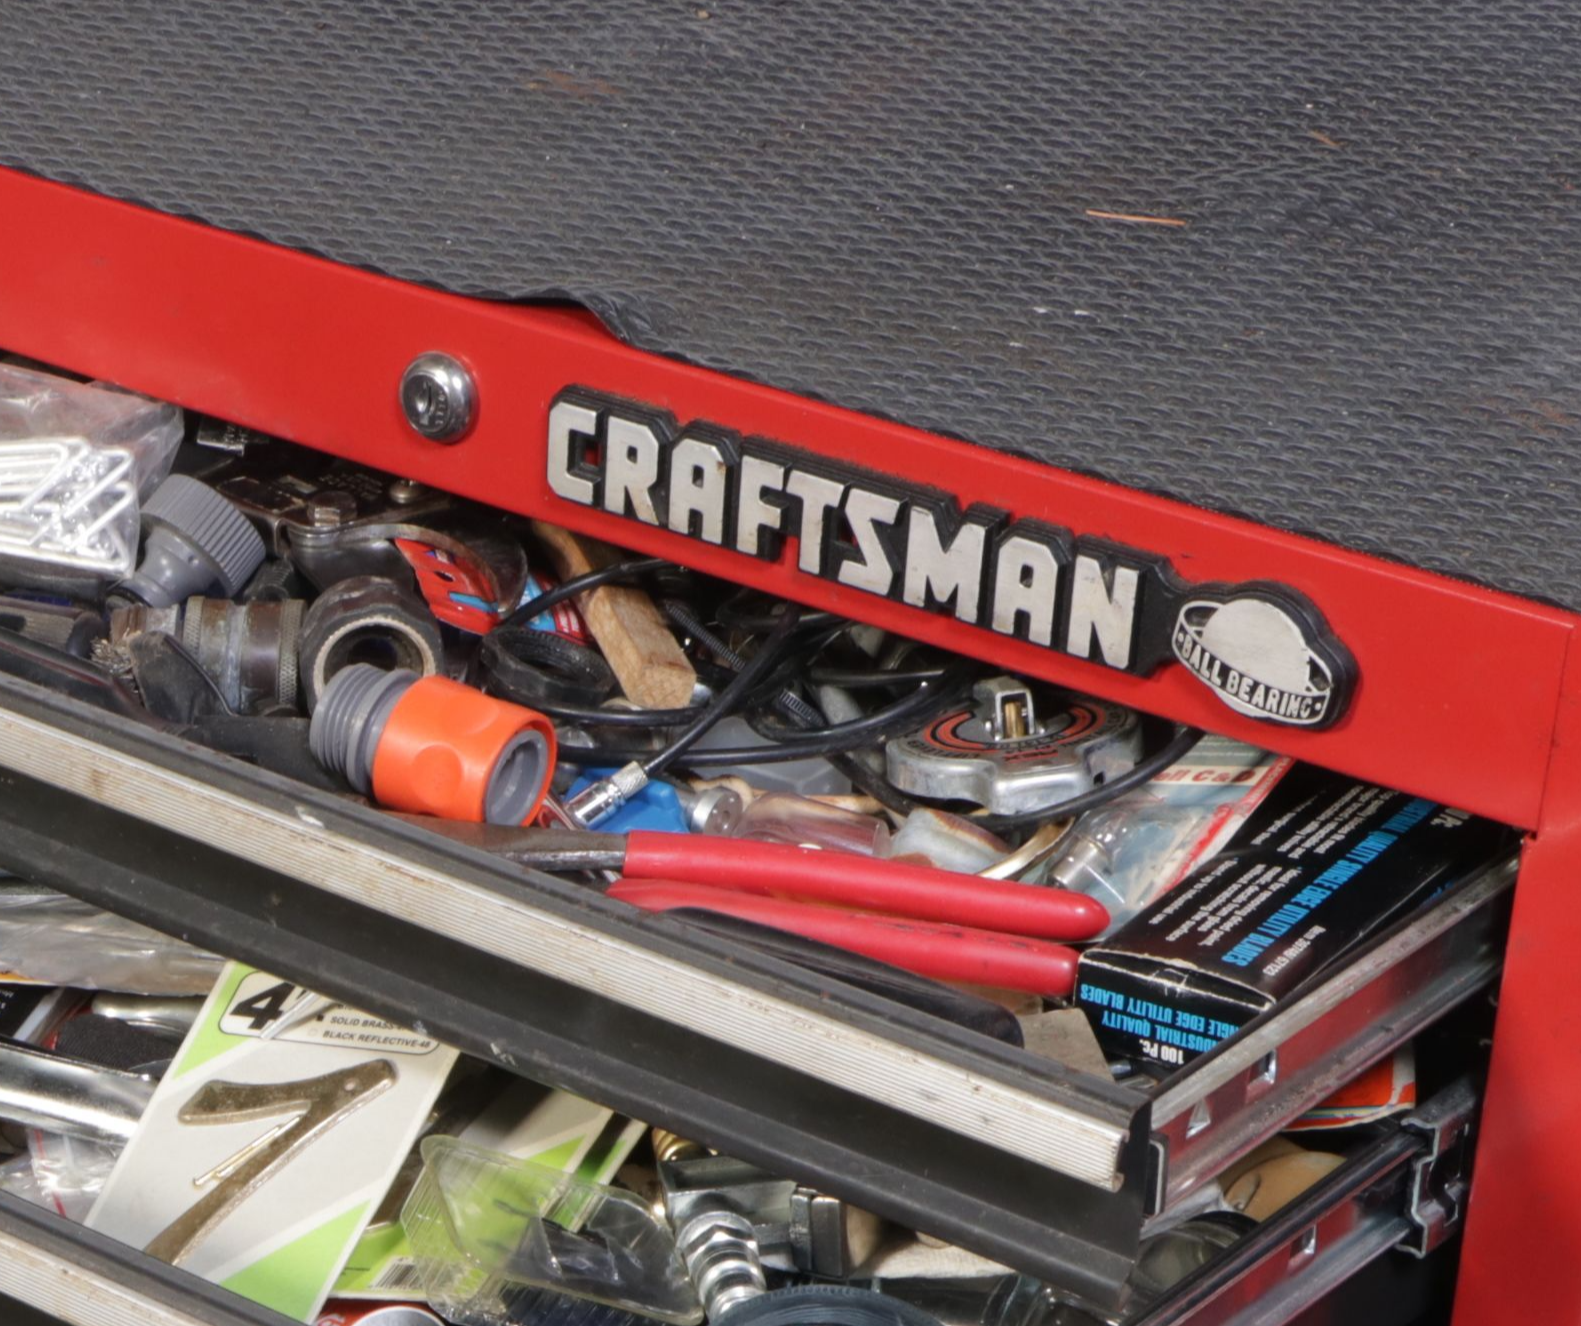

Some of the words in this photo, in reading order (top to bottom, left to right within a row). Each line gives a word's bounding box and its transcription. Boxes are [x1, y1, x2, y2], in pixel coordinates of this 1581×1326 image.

[546, 400, 1139, 671] CRAFTSMAN
[1182, 632, 1222, 688] BALL
[1224, 670, 1312, 722] BEARING
[1345, 830, 1398, 865] QUALITY
[1313, 857, 1362, 889] SINGLE
[1292, 883, 1332, 909] EDGE
[1257, 903, 1309, 938] UTILITY
[1221, 932, 1275, 968] BLADES
[1079, 983, 1123, 1009] BLADES
[330, 1015, 361, 1027] SOLID
[362, 1017, 407, 1031] BRASS-
[1101, 1010, 1151, 1036] QUALITY
[1127, 997, 1172, 1023] UTILITY
[1174, 1010, 1205, 1030] EDGE
[323, 1030, 356, 1041] BLACK
[1138, 1038, 1158, 1056] Pc.
[1160, 1044, 1183, 1064] 100
